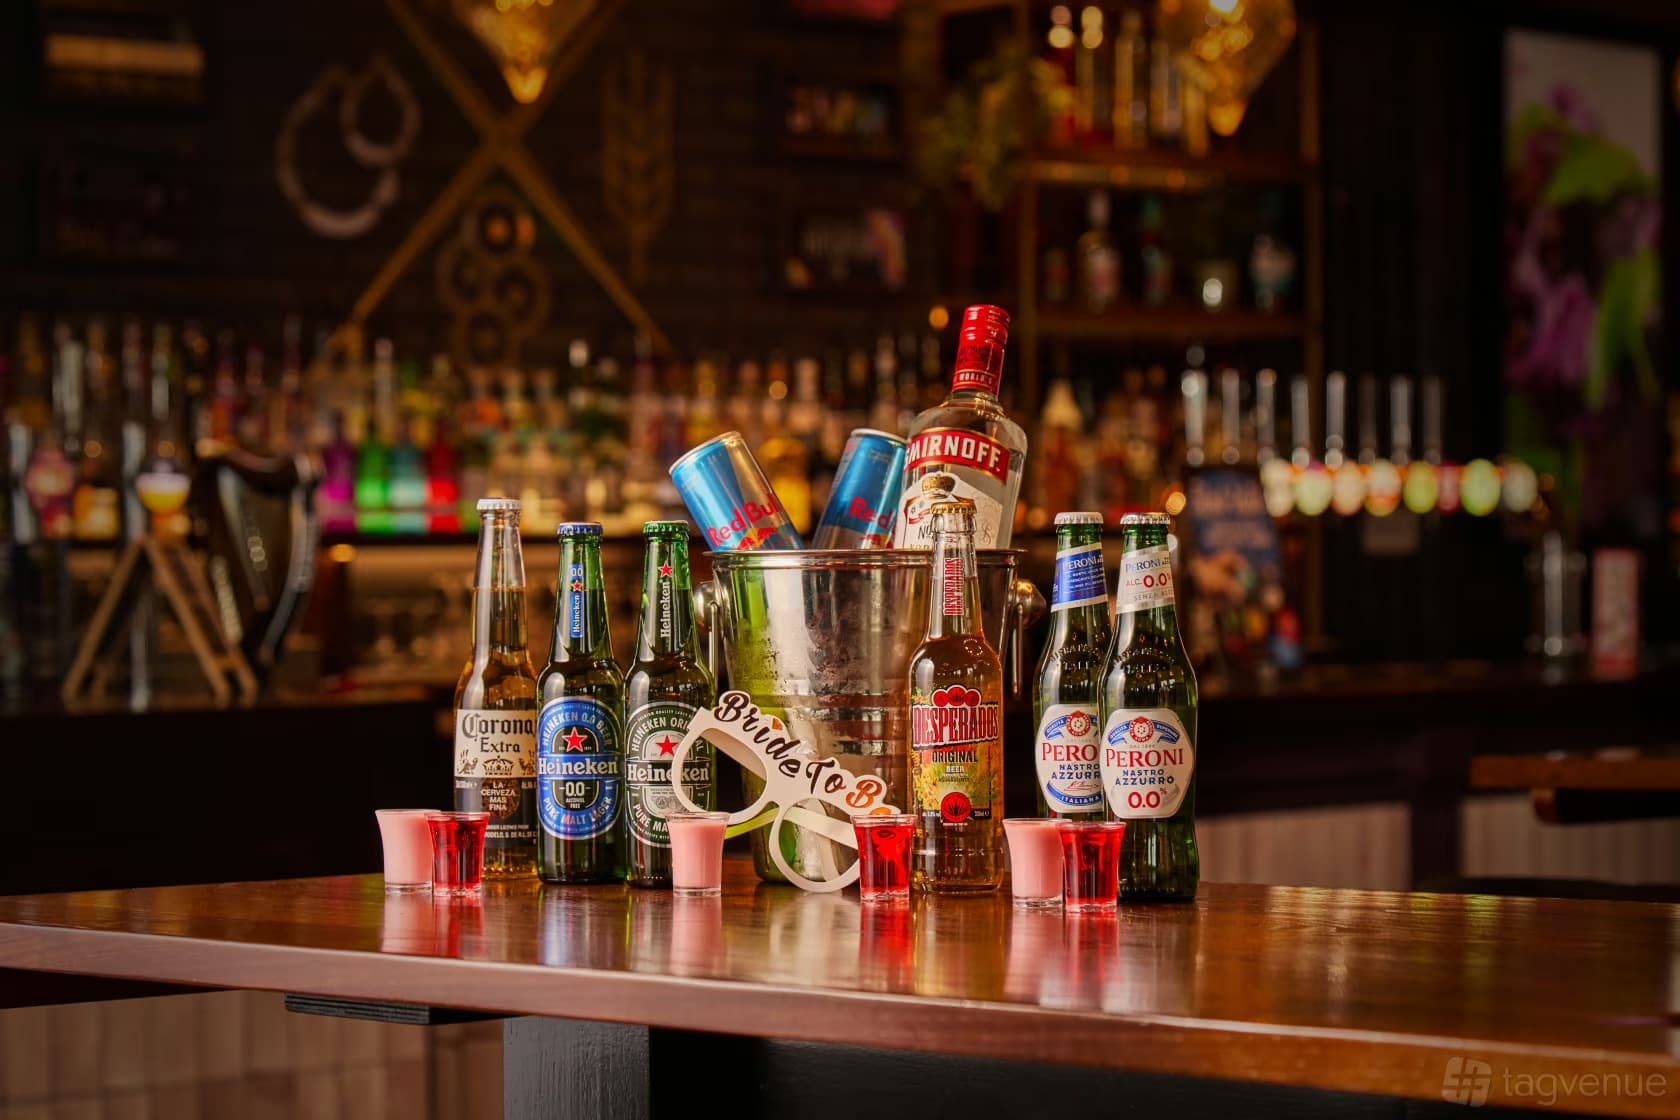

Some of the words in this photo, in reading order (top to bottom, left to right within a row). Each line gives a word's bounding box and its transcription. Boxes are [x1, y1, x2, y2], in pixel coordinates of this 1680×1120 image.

[849, 497, 895, 530] Red
[707, 508, 749, 549] Red
[1126, 558, 1162, 573] PERONI
[944, 558, 964, 616] DESPERADOS
[573, 594, 581, 634] Heineken
[660, 581, 671, 638] Heineken
[462, 713, 536, 742] Corona
[541, 712, 580, 748] HEINEKEN
[595, 719, 614, 748] BEER
[632, 717, 667, 753] HEINEKEN
[913, 705, 998, 747] DESPERADOS
[480, 737, 521, 754] Extra
[713, 692, 801, 779] Bride
[805, 759, 847, 795] To
[1042, 742, 1099, 762] PERO
[537, 758, 619, 775] Heineken
[932, 750, 978, 763] ORIGINAL
[1105, 748, 1184, 768] PERONI
[1051, 771, 1101, 780] AZZURR
[1059, 763, 1101, 772] NASTRO
[1122, 768, 1165, 778] NASTRO
[493, 781, 505, 789] LA
[565, 781, 586, 798] 0.0
[1114, 776, 1175, 787] AZZURRO
[480, 788, 517, 798] CERVEZA
[1060, 795, 1101, 804] ITALIANA
[488, 803, 508, 812] FINA
[543, 796, 560, 822] PURE
[560, 813, 587, 826] MALT
[588, 796, 614, 822] LAGER
[632, 802, 653, 828] PURE
[652, 820, 669, 833] MA
